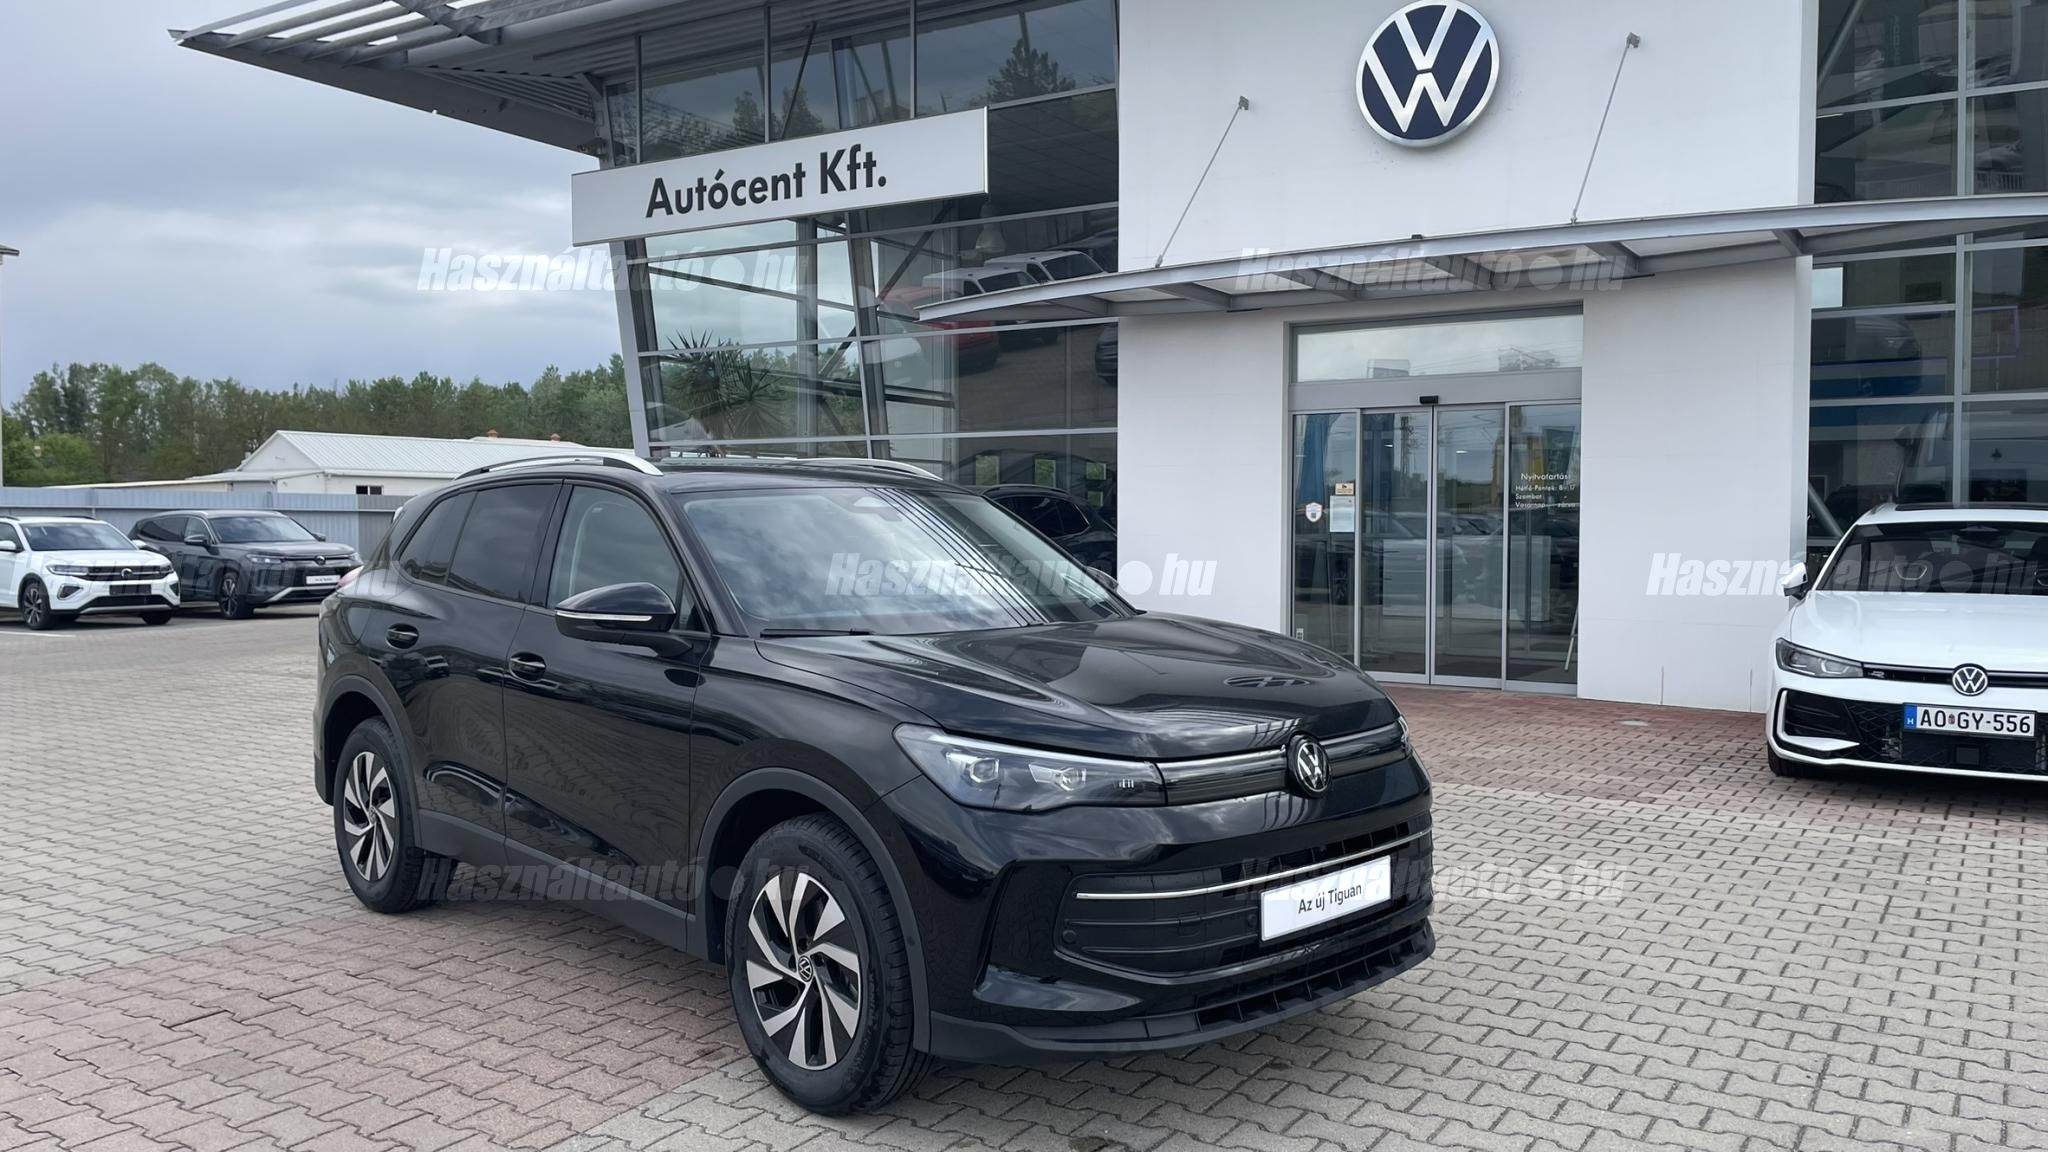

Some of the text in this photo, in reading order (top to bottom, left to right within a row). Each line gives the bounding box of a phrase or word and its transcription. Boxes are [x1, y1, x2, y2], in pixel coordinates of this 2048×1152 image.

[1357, 0, 1499, 146] VW
[645, 143, 887, 218] Autócent Kft.
[1298, 884, 1362, 914] Az új Tiguan
